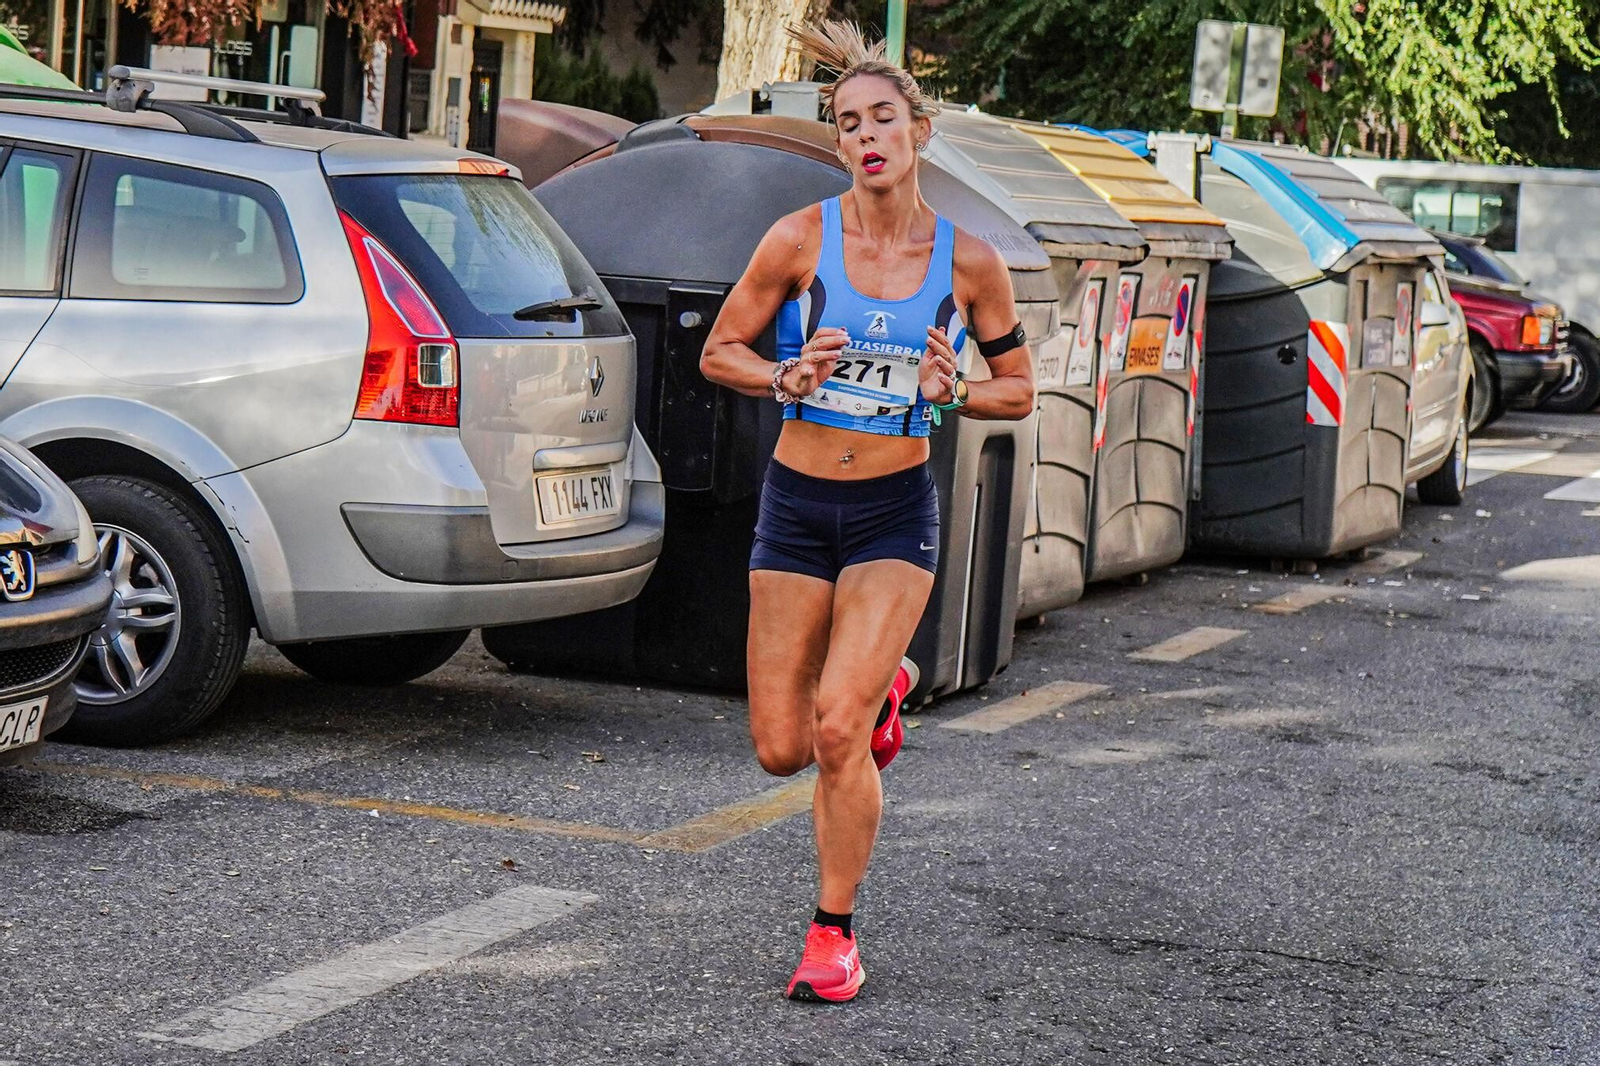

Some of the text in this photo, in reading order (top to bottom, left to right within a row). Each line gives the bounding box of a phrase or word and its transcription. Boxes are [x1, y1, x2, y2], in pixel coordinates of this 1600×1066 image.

[1129, 346, 1160, 367] ENVASES
[831, 359, 891, 388] 271
[552, 476, 613, 515] 1144 FXY
